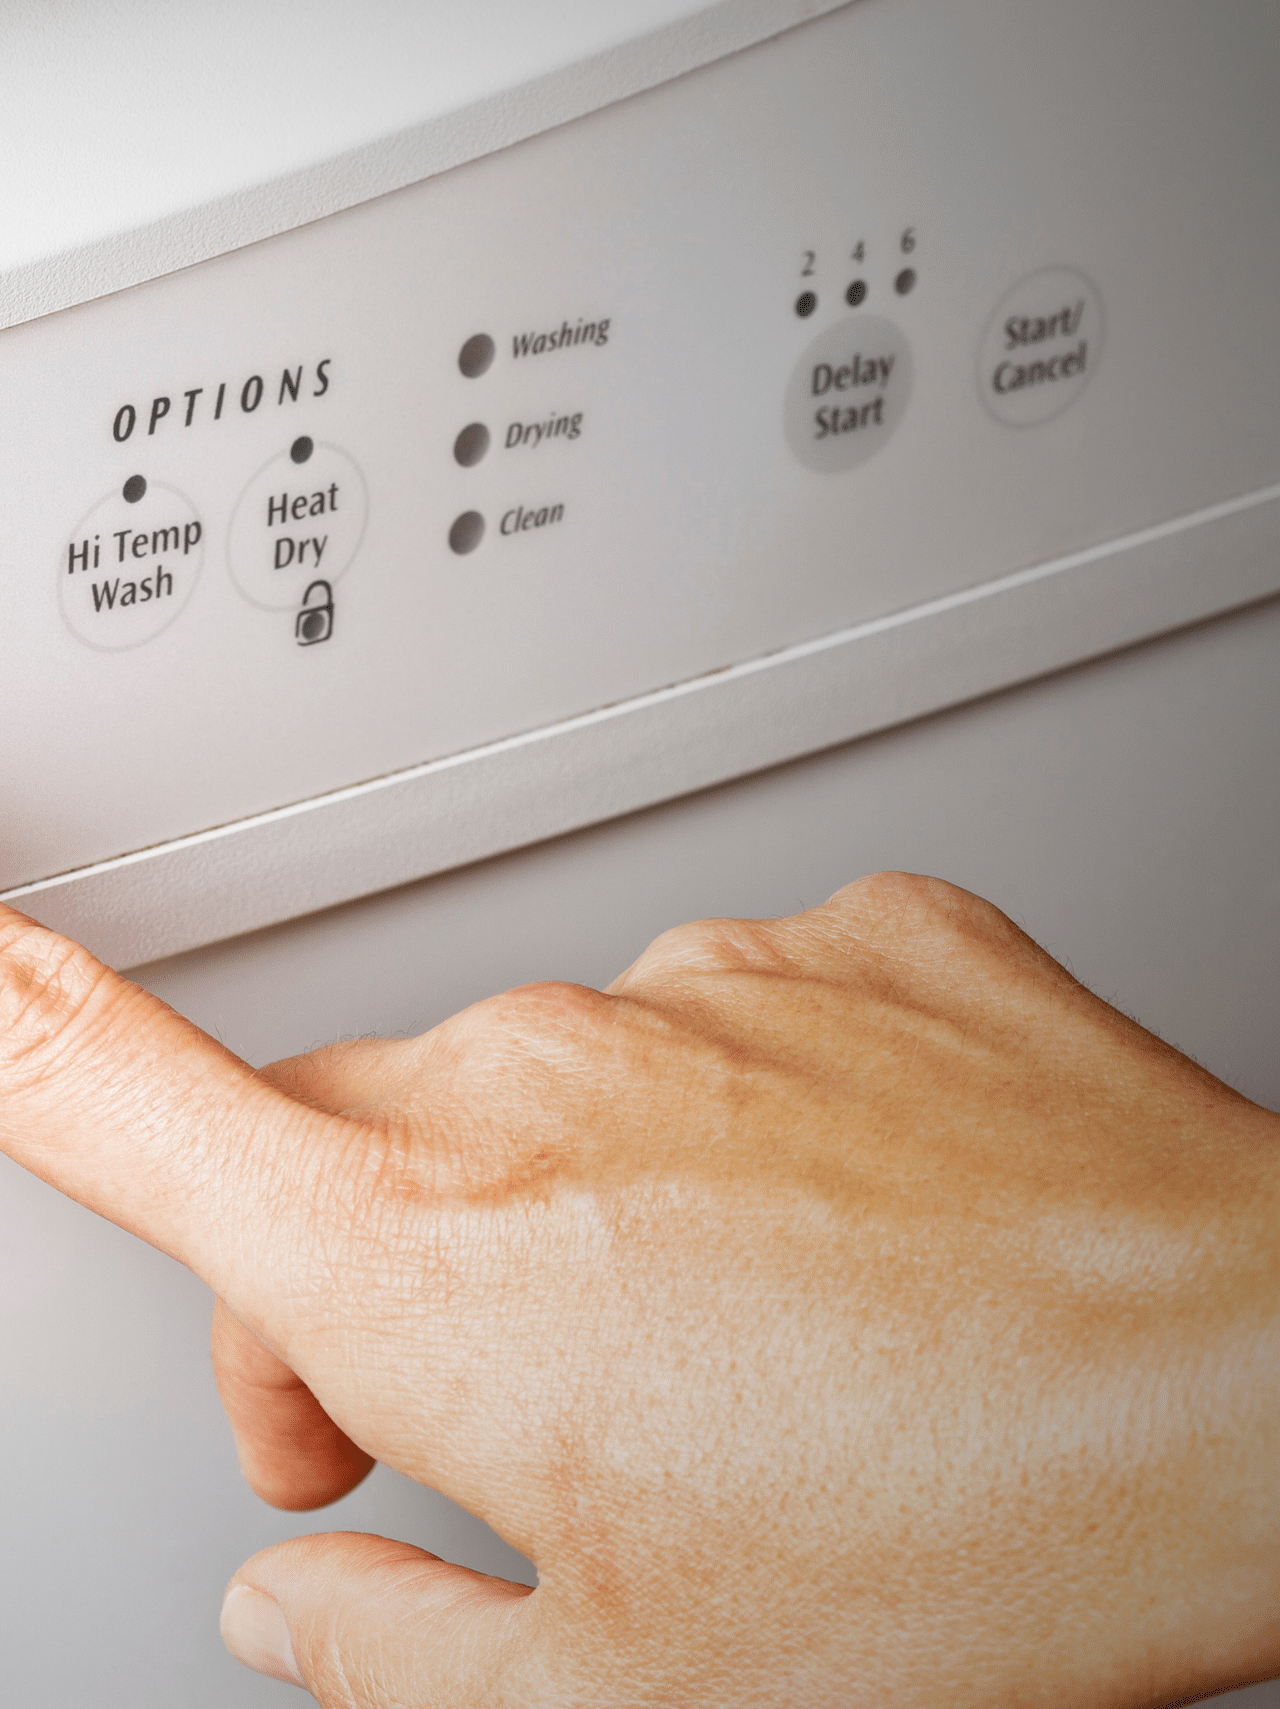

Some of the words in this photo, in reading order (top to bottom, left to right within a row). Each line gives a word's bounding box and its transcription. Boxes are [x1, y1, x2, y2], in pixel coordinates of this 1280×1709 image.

[800, 249, 816, 276] 2
[851, 240, 866, 266] 4
[901, 228, 916, 253] 6
[511, 316, 612, 360] Washing
[1003, 299, 1086, 350] Start/
[810, 353, 896, 397] Delay
[992, 340, 1090, 394] Cancel
[111, 358, 334, 443] OPTIONS
[814, 397, 885, 440] Start
[503, 411, 585, 450] Drying
[266, 481, 341, 528] Heat
[498, 500, 567, 537] Clean
[67, 534, 102, 576] Hi
[112, 519, 205, 564] Temp
[272, 533, 329, 572] Dry
[91, 563, 174, 614] Wash
